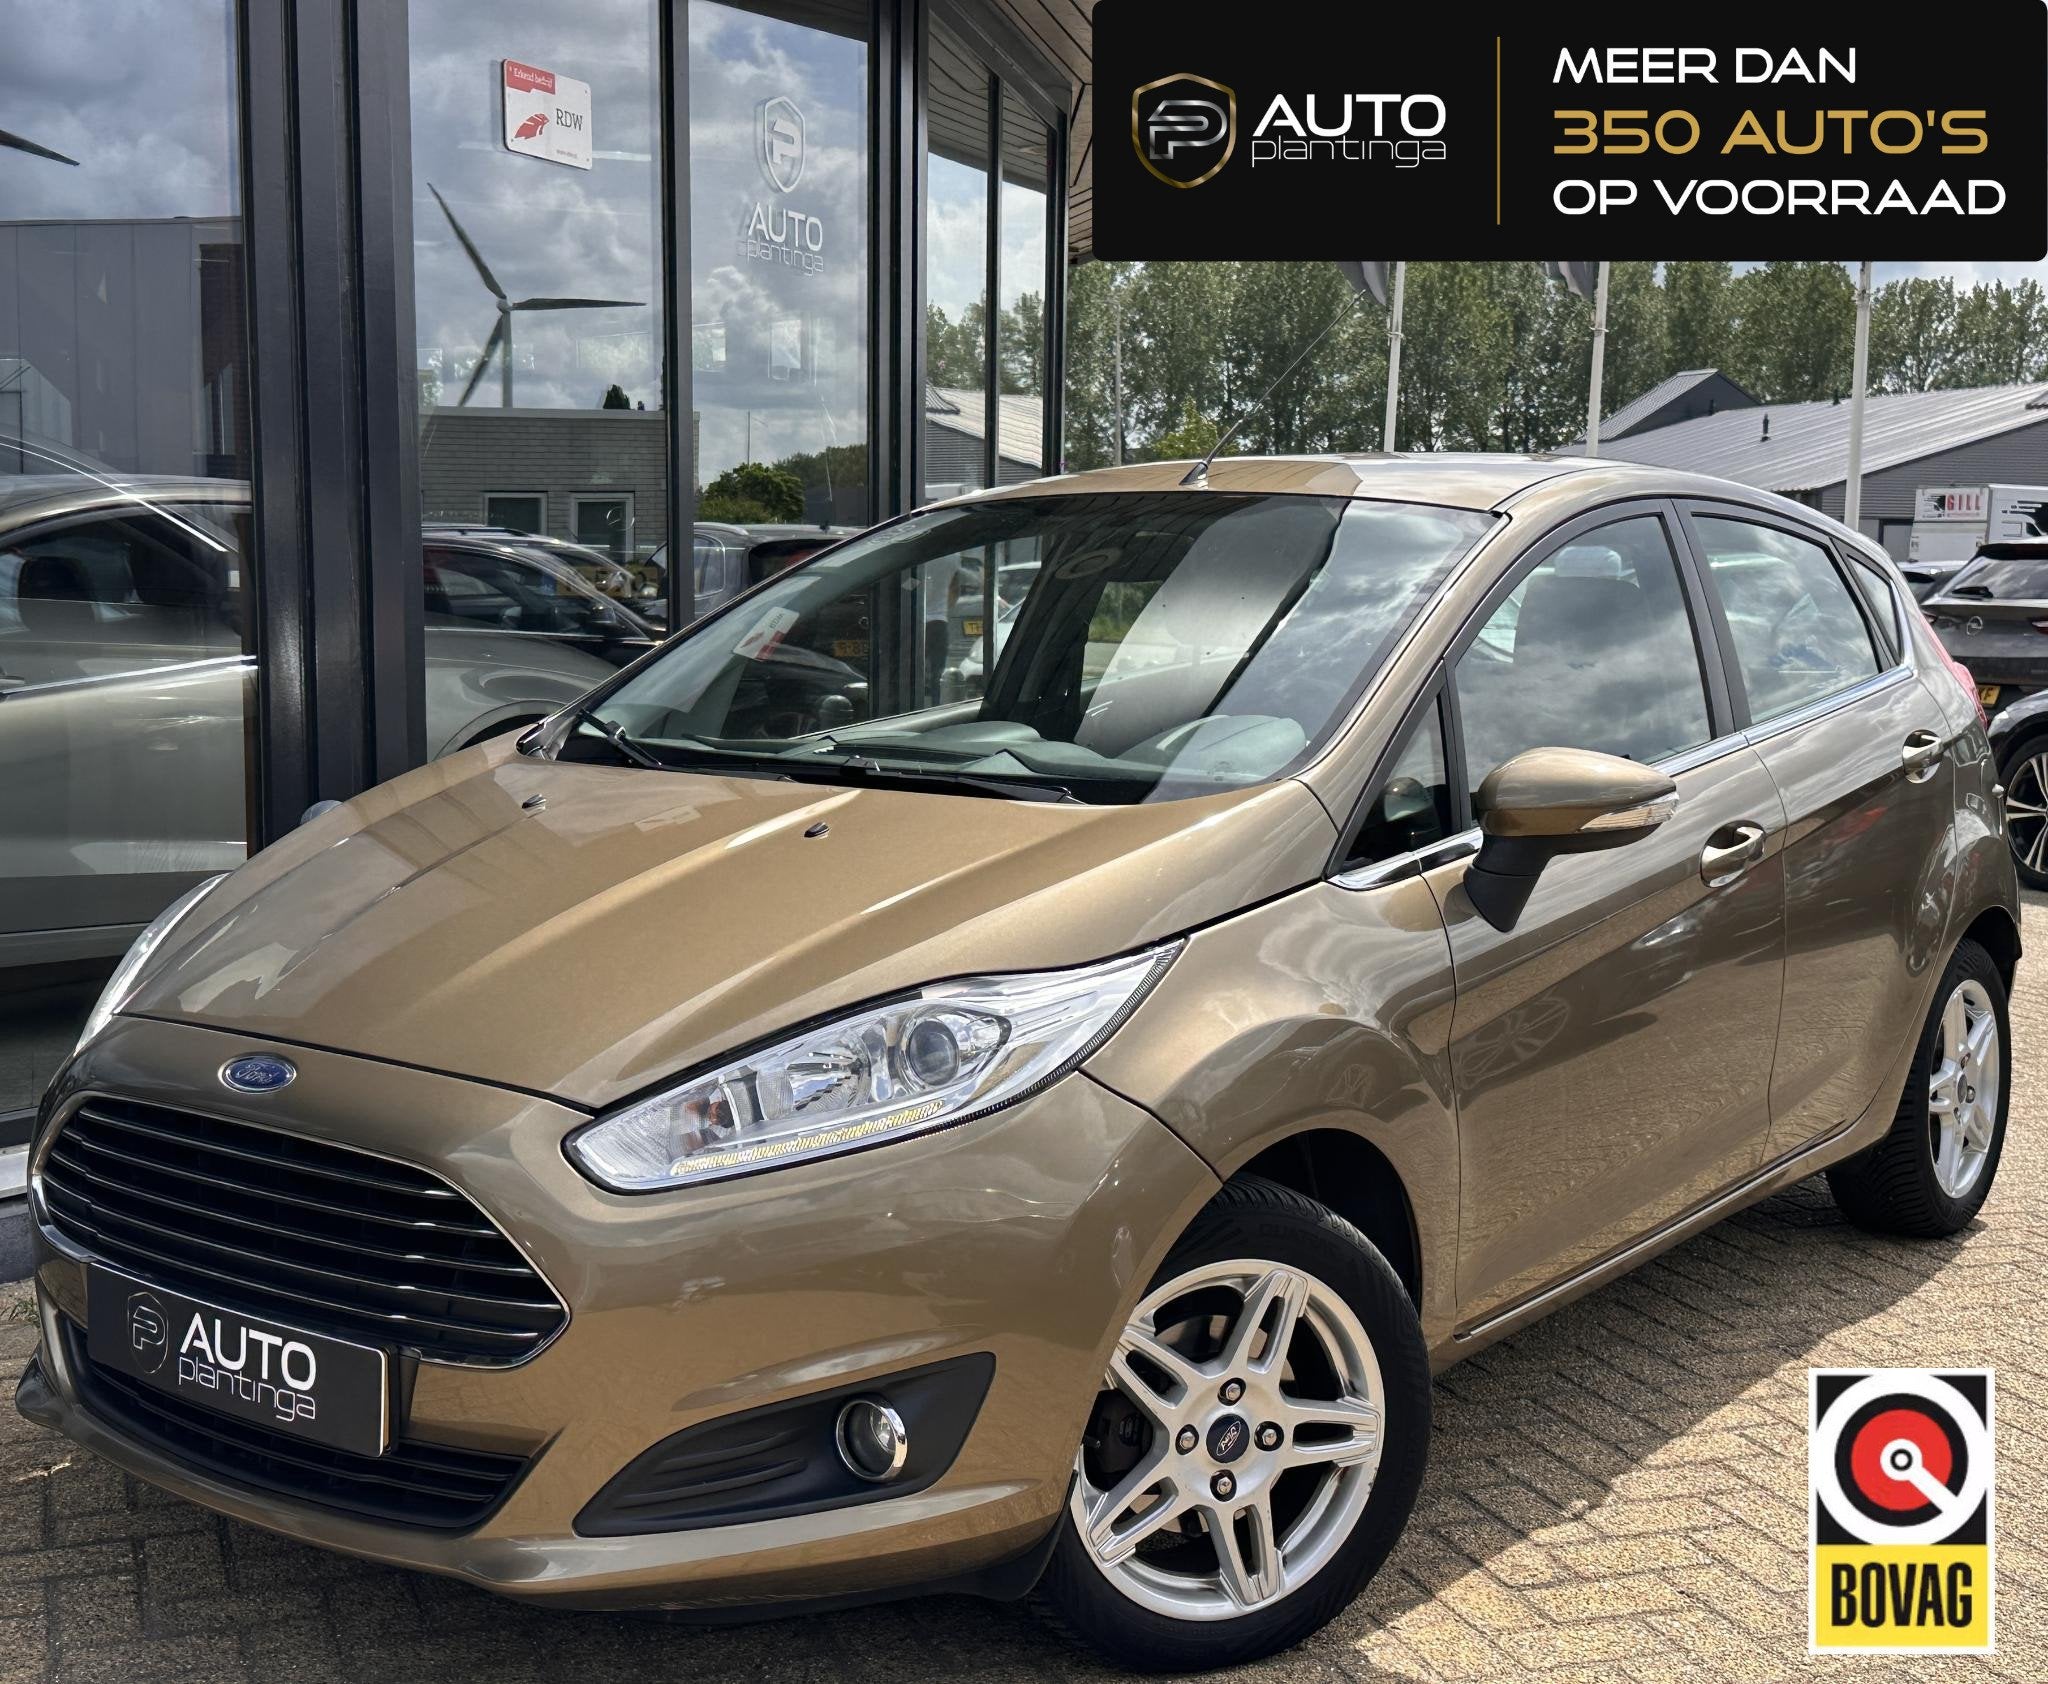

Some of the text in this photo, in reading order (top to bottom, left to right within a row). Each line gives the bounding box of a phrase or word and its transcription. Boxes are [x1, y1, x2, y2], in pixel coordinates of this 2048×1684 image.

[556, 107, 583, 131] RDW
[748, 202, 823, 251] AUTO
[1947, 494, 1981, 511] GILL
[180, 1312, 317, 1391] AUTO
[178, 1356, 316, 1422] plantinga
